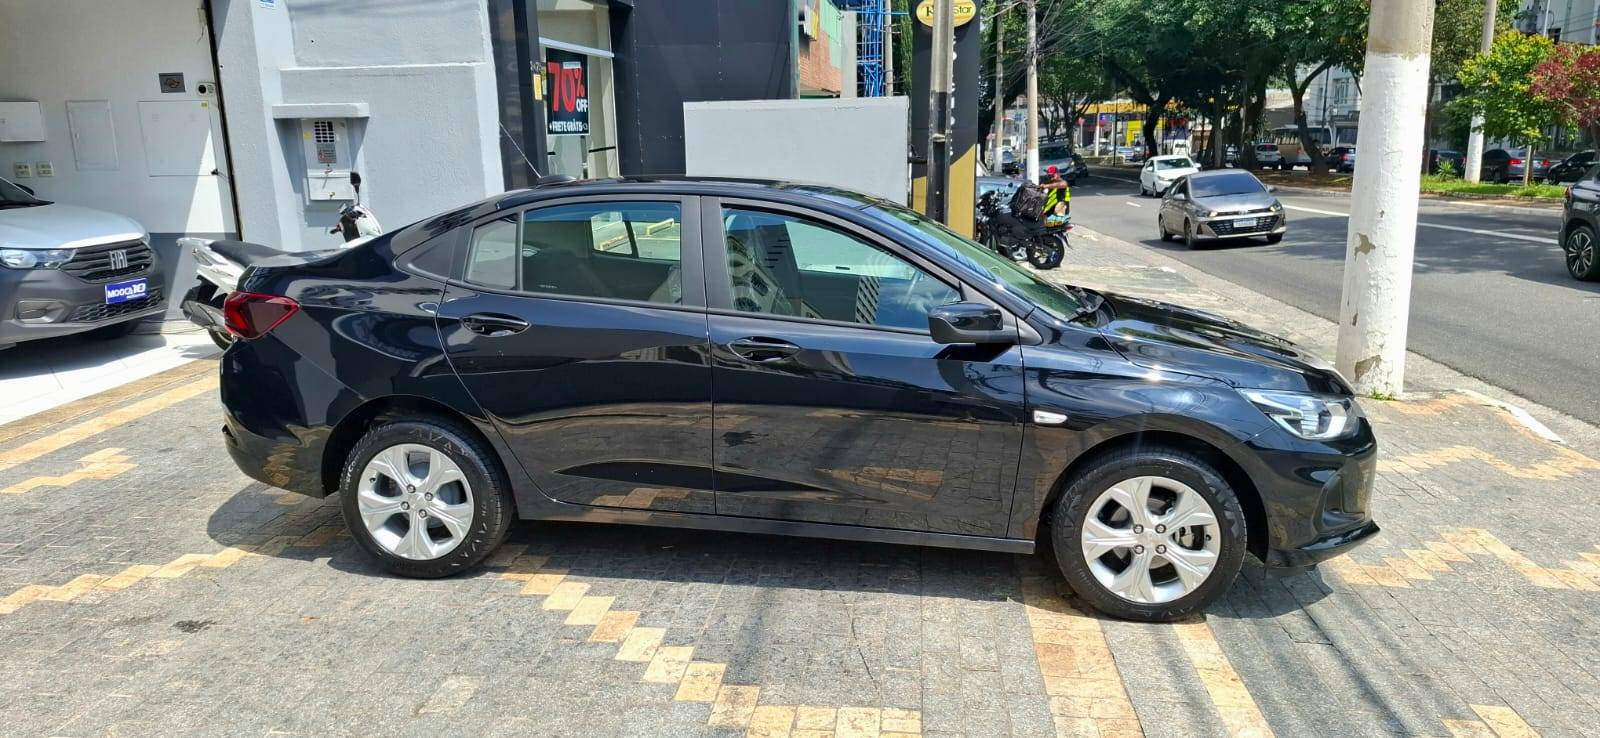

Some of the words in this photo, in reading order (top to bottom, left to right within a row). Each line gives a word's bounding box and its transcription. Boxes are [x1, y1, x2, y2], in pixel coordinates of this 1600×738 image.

[548, 62, 585, 112] 70%
[576, 98, 588, 112] OFF
[109, 250, 128, 269] FIAT
